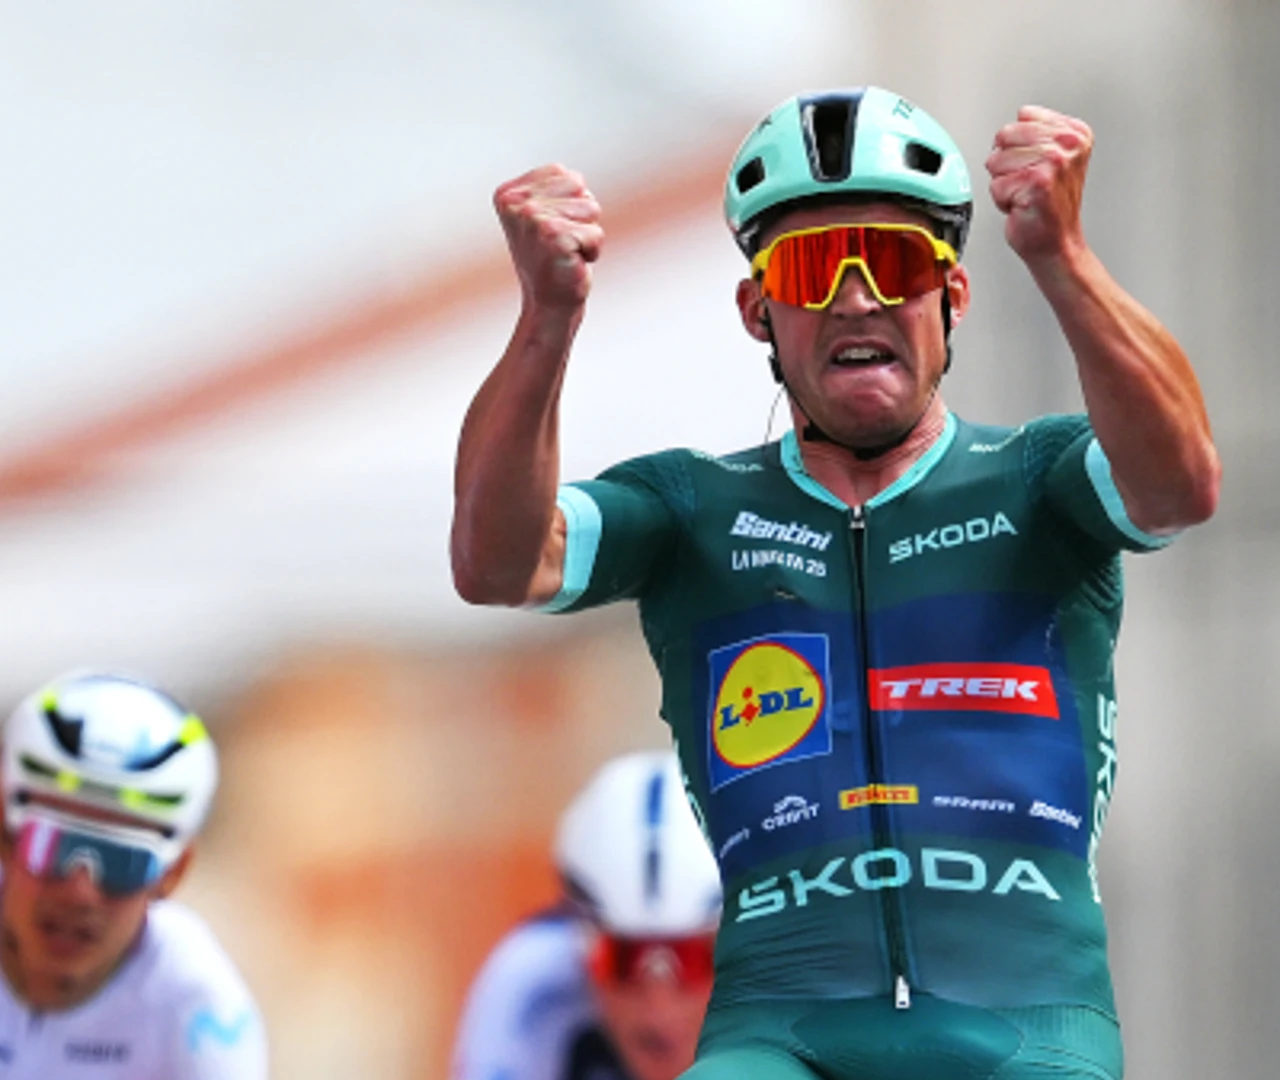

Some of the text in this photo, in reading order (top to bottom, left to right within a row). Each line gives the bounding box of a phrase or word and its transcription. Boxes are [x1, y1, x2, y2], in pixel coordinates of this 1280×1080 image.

[729, 511, 833, 551] Santini
[732, 550, 749, 571] LA
[805, 559, 827, 577] 25
[880, 677, 1040, 702] TREK
